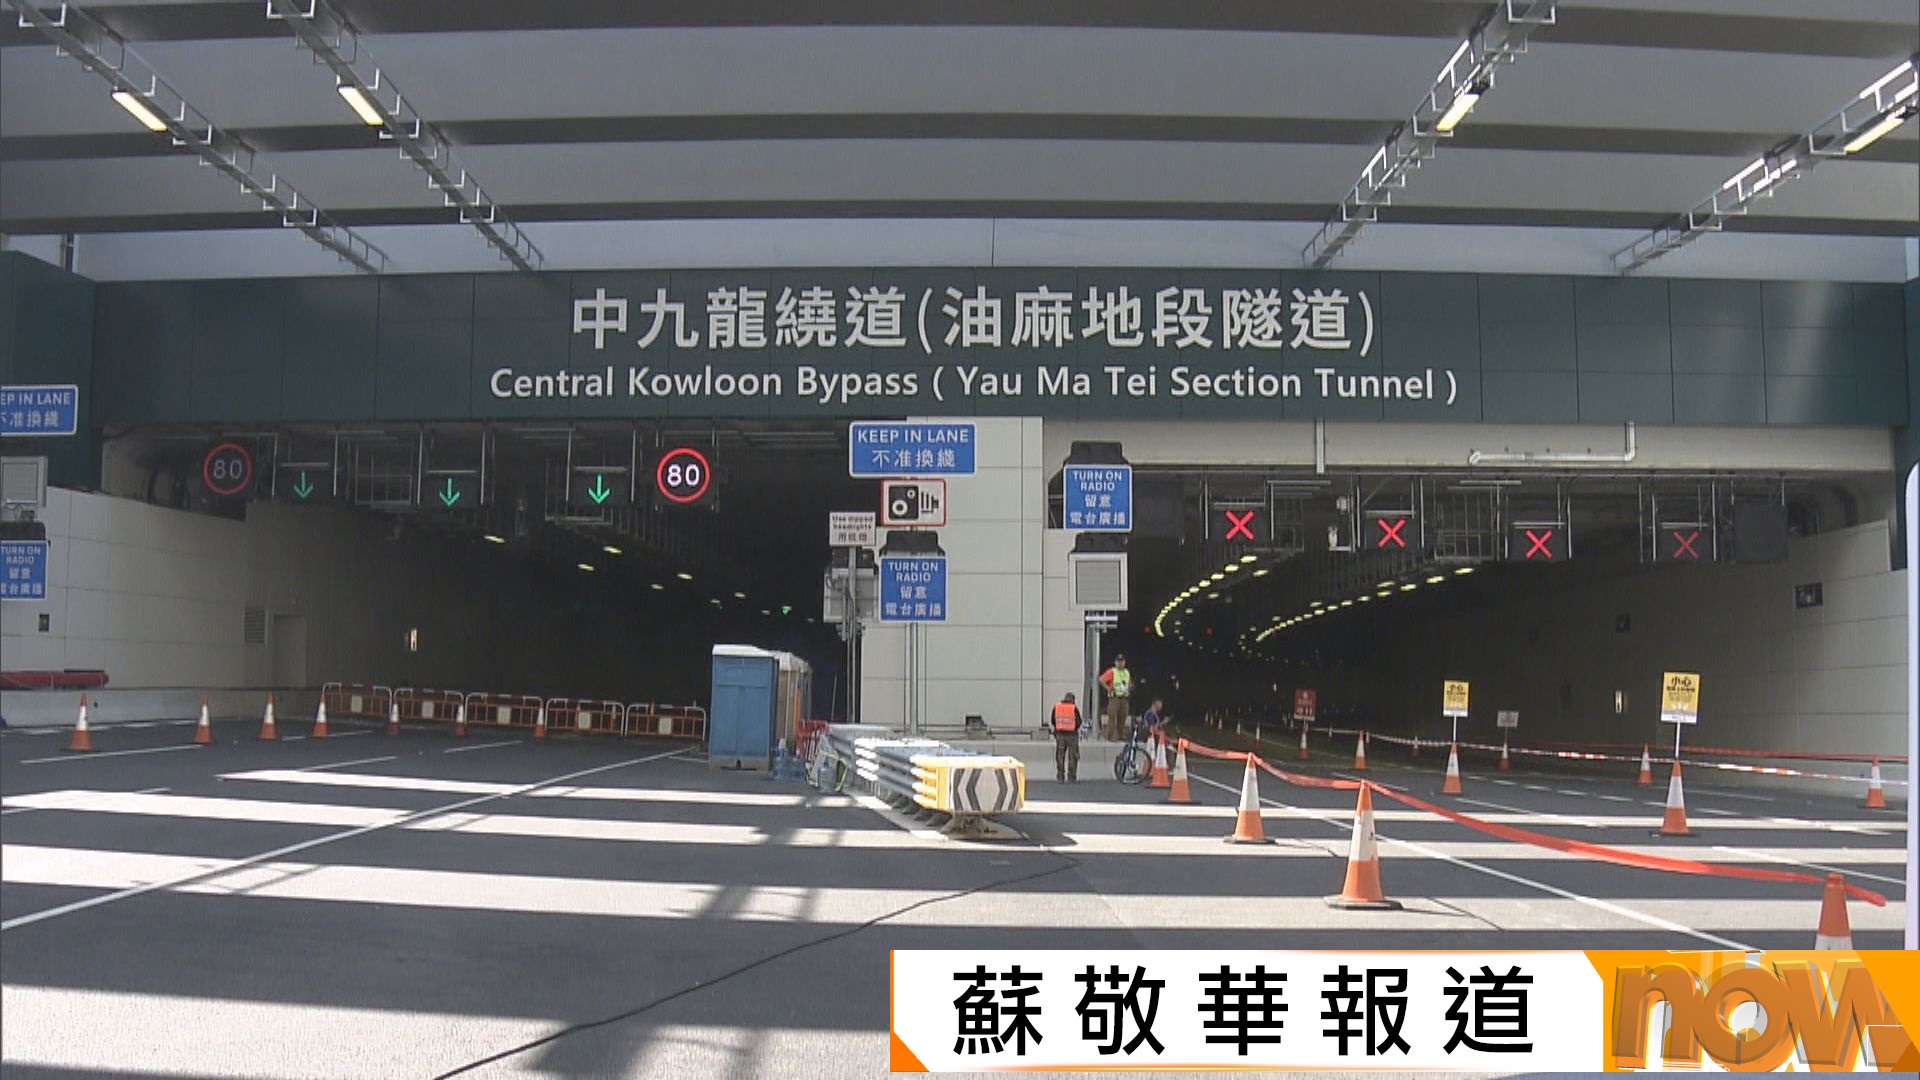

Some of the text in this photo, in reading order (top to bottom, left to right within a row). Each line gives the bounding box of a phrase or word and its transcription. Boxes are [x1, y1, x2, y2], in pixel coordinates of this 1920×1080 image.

[572, 285, 1375, 357] 中九龍繞道(油麻地段隧道)
[490, 366, 613, 397] Central
[629, 365, 782, 396] Kowloon
[797, 366, 918, 404] Bypass
[956, 366, 1022, 396] Yau
[1037, 366, 1090, 396] Ma
[1103, 365, 1156, 396] Tei
[1171, 366, 1301, 397] Section
[1313, 368, 1433, 399] Tunnel
[18, 392, 33, 406] IN
[37, 392, 71, 406] LANE
[857, 429, 969, 444] KEEP IN LANE
[212, 458, 244, 480] 80
[666, 463, 700, 487] 80
[1073, 470, 1123, 481] TURN ON
[1080, 481, 1116, 492] RADIO
[6, 556, 35, 565] RADIO
[888, 561, 939, 572] TURN ON
[896, 572, 931, 582] RADIO
